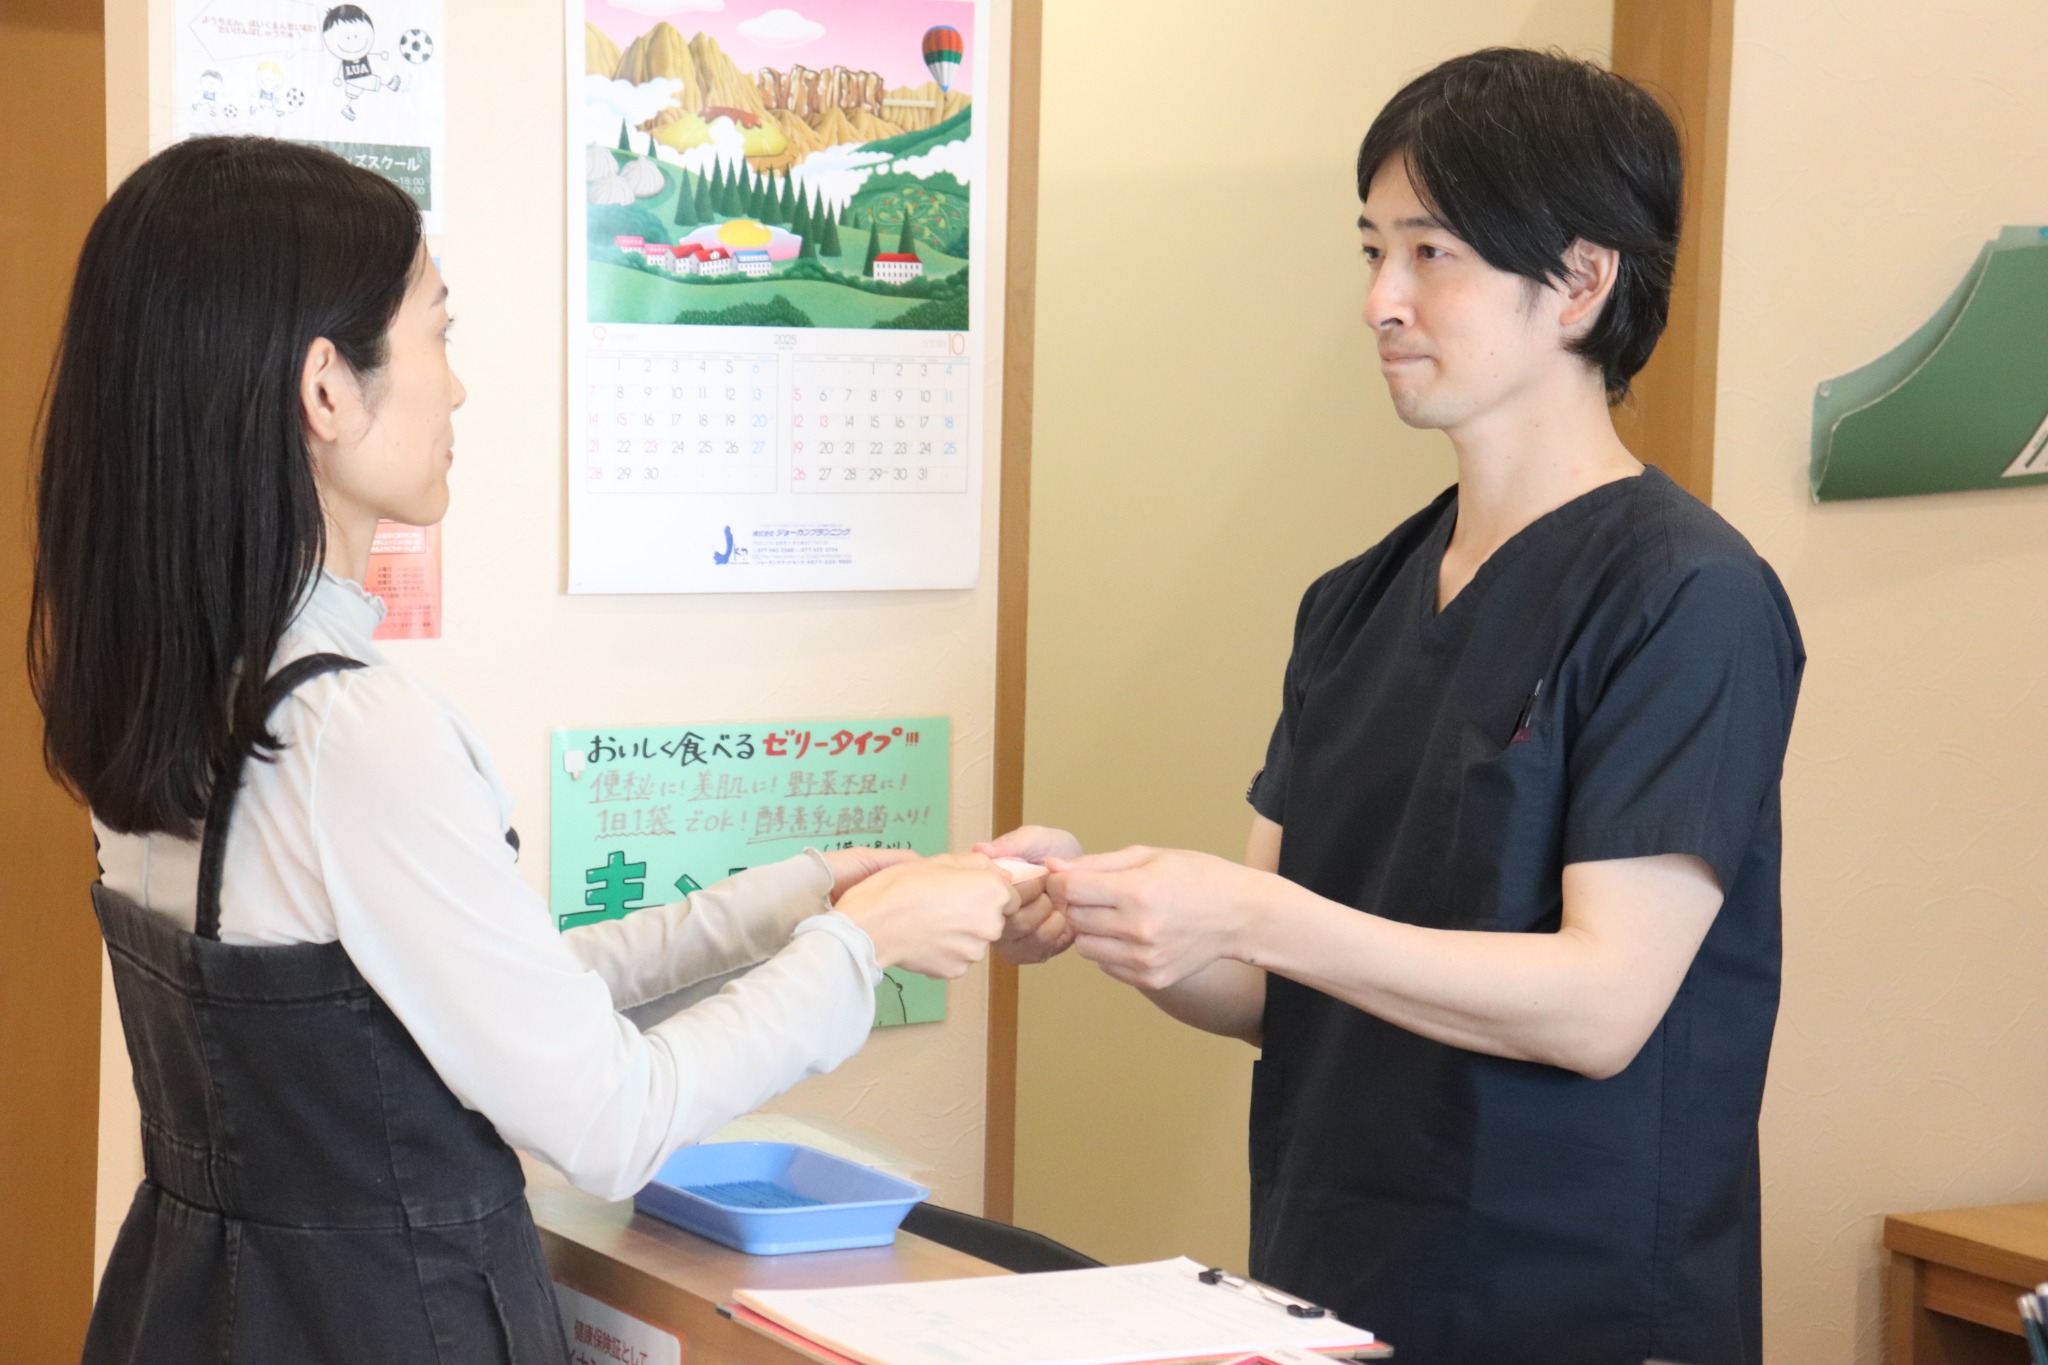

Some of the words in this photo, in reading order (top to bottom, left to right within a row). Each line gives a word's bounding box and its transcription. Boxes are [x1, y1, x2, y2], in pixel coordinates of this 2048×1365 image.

[345, 63, 369, 76] LUA
[774, 333, 797, 345] 2025
[948, 332, 965, 355] 10
[896, 364, 903, 376] 2
[921, 364, 927, 377] 3
[946, 364, 953, 376] 4
[794, 388, 801, 401] 5
[820, 390, 827, 402] 6
[846, 389, 852, 400] 7
[871, 390, 877, 402] 8
[896, 390, 903, 402] 9
[921, 390, 931, 403] 10
[945, 390, 953, 403] 11
[794, 415, 803, 428] 12
[820, 416, 829, 428] 13
[846, 416, 854, 426] 14
[870, 416, 880, 428] 15
[896, 416, 904, 428] 16
[920, 416, 929, 428] 17
[945, 417, 953, 428] 18
[793, 442, 803, 453] 19
[819, 442, 834, 454] 20
[845, 442, 854, 454] 21
[870, 442, 883, 454] 22
[895, 442, 907, 455] 23
[919, 442, 931, 454] 24
[944, 442, 957, 454] 25
[794, 468, 806, 480] 26
[819, 468, 832, 480] 27
[844, 468, 856, 480] 28
[869, 468, 882, 480] 29
[894, 468, 907, 480] 30
[918, 468, 927, 480] 31
[587, 731, 756, 766] おいしく食べる
